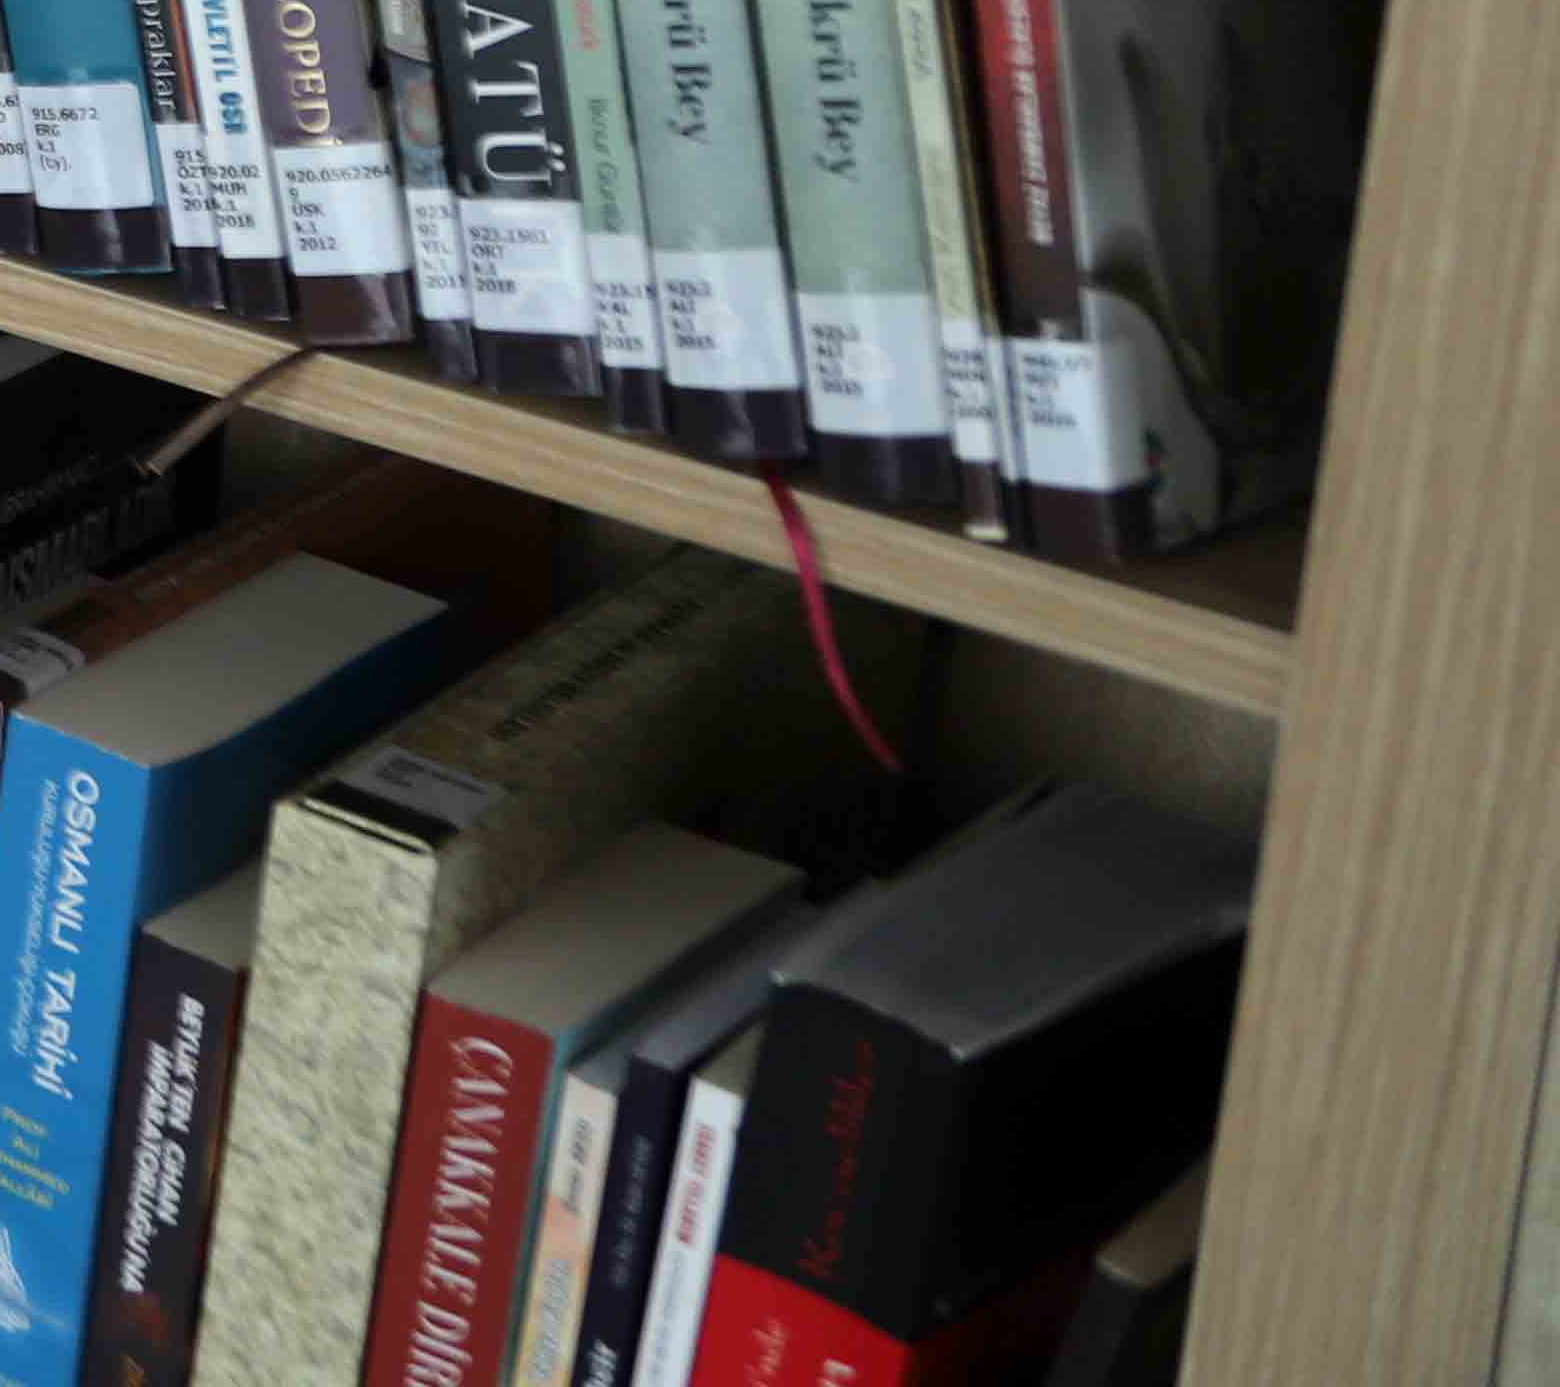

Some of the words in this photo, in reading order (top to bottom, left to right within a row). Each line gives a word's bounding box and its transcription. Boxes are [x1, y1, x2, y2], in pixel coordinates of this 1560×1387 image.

[665, 59, 713, 146] Bey
[816, 93, 864, 184] Bey
[49, 770, 100, 955] OSMANLI
[32, 968, 76, 1103] TARİHİ
[423, 1036, 514, 1306] ÇANAKKALE
